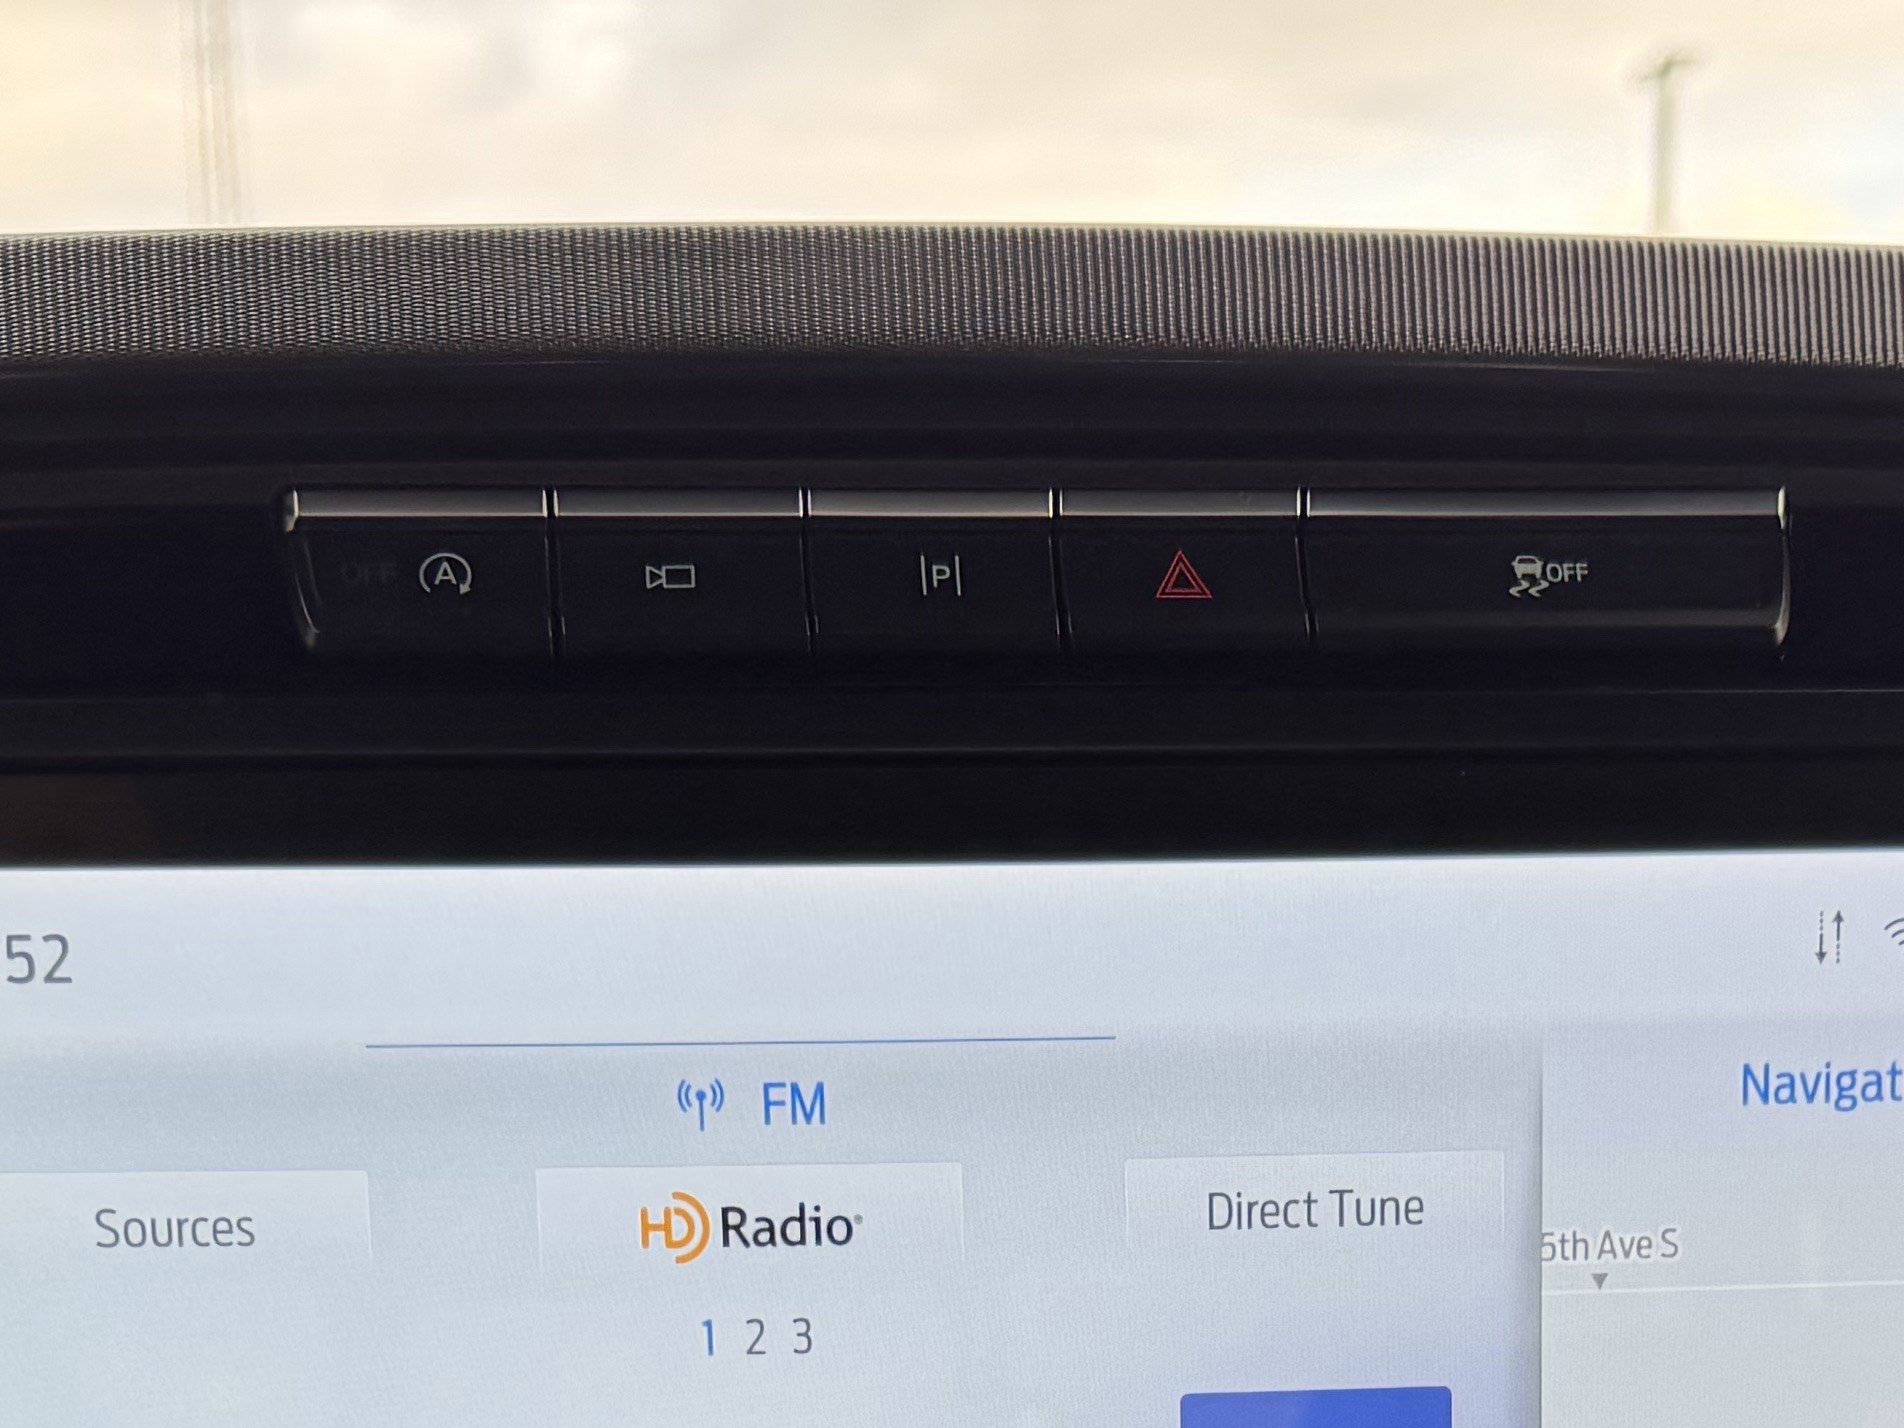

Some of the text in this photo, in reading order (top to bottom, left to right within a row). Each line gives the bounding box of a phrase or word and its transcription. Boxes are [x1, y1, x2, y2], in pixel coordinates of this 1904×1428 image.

[1545, 561, 1589, 583] OFF
[762, 1081, 827, 1126] FM
[95, 1208, 256, 1250] Sources
[639, 1191, 711, 1264] HD
[1208, 1189, 1425, 1231] Direct Tune
[1597, 1230, 1653, 1260] Ave
[1660, 1228, 1679, 1258] S
[702, 1317, 814, 1356] 1 2 3
